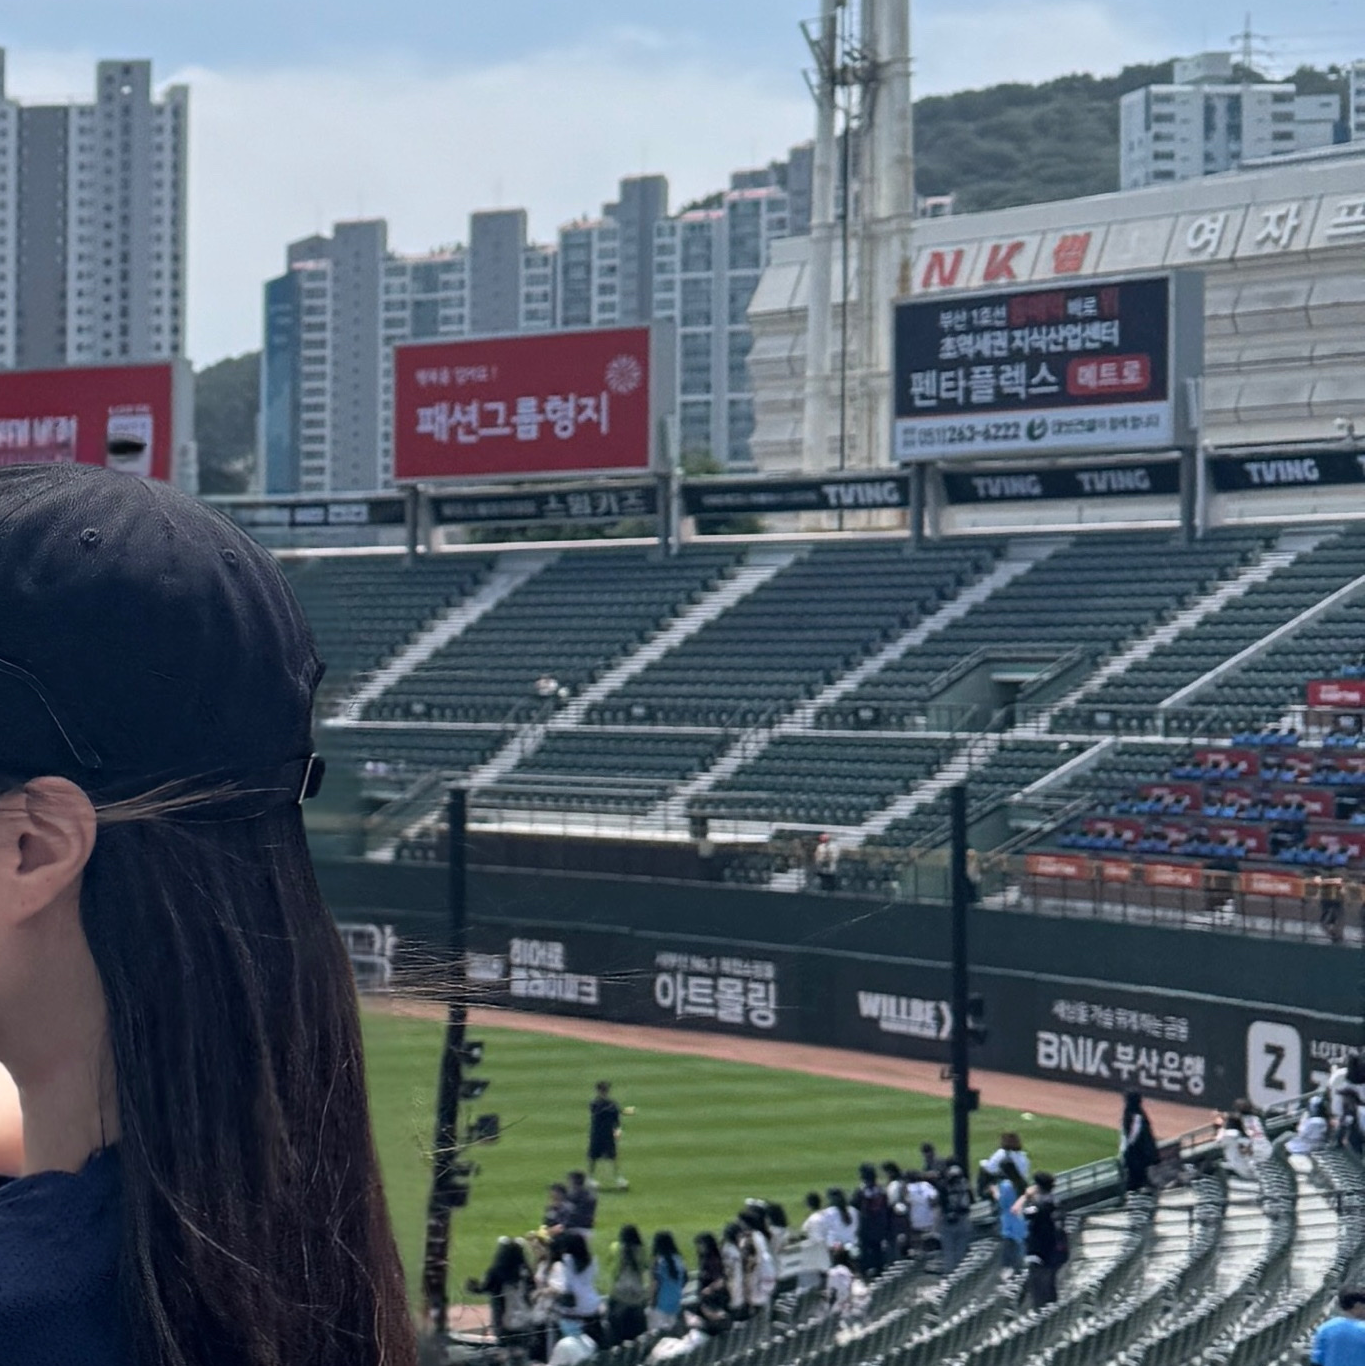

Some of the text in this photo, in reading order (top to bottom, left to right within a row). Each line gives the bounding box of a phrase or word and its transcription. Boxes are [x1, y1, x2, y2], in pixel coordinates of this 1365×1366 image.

[909, 359, 1144, 408] 펜타플렉스 메트로
[415, 391, 609, 445] 패션그룹형지
[822, 481, 900, 507] TVING
[972, 467, 1151, 497] TVING TVING
[1244, 458, 1320, 484] TVING
[654, 971, 777, 1029] 아트몰링
[1036, 1030, 1206, 1096] BNK 부산은행
[1263, 1043, 1287, 1090] Z
